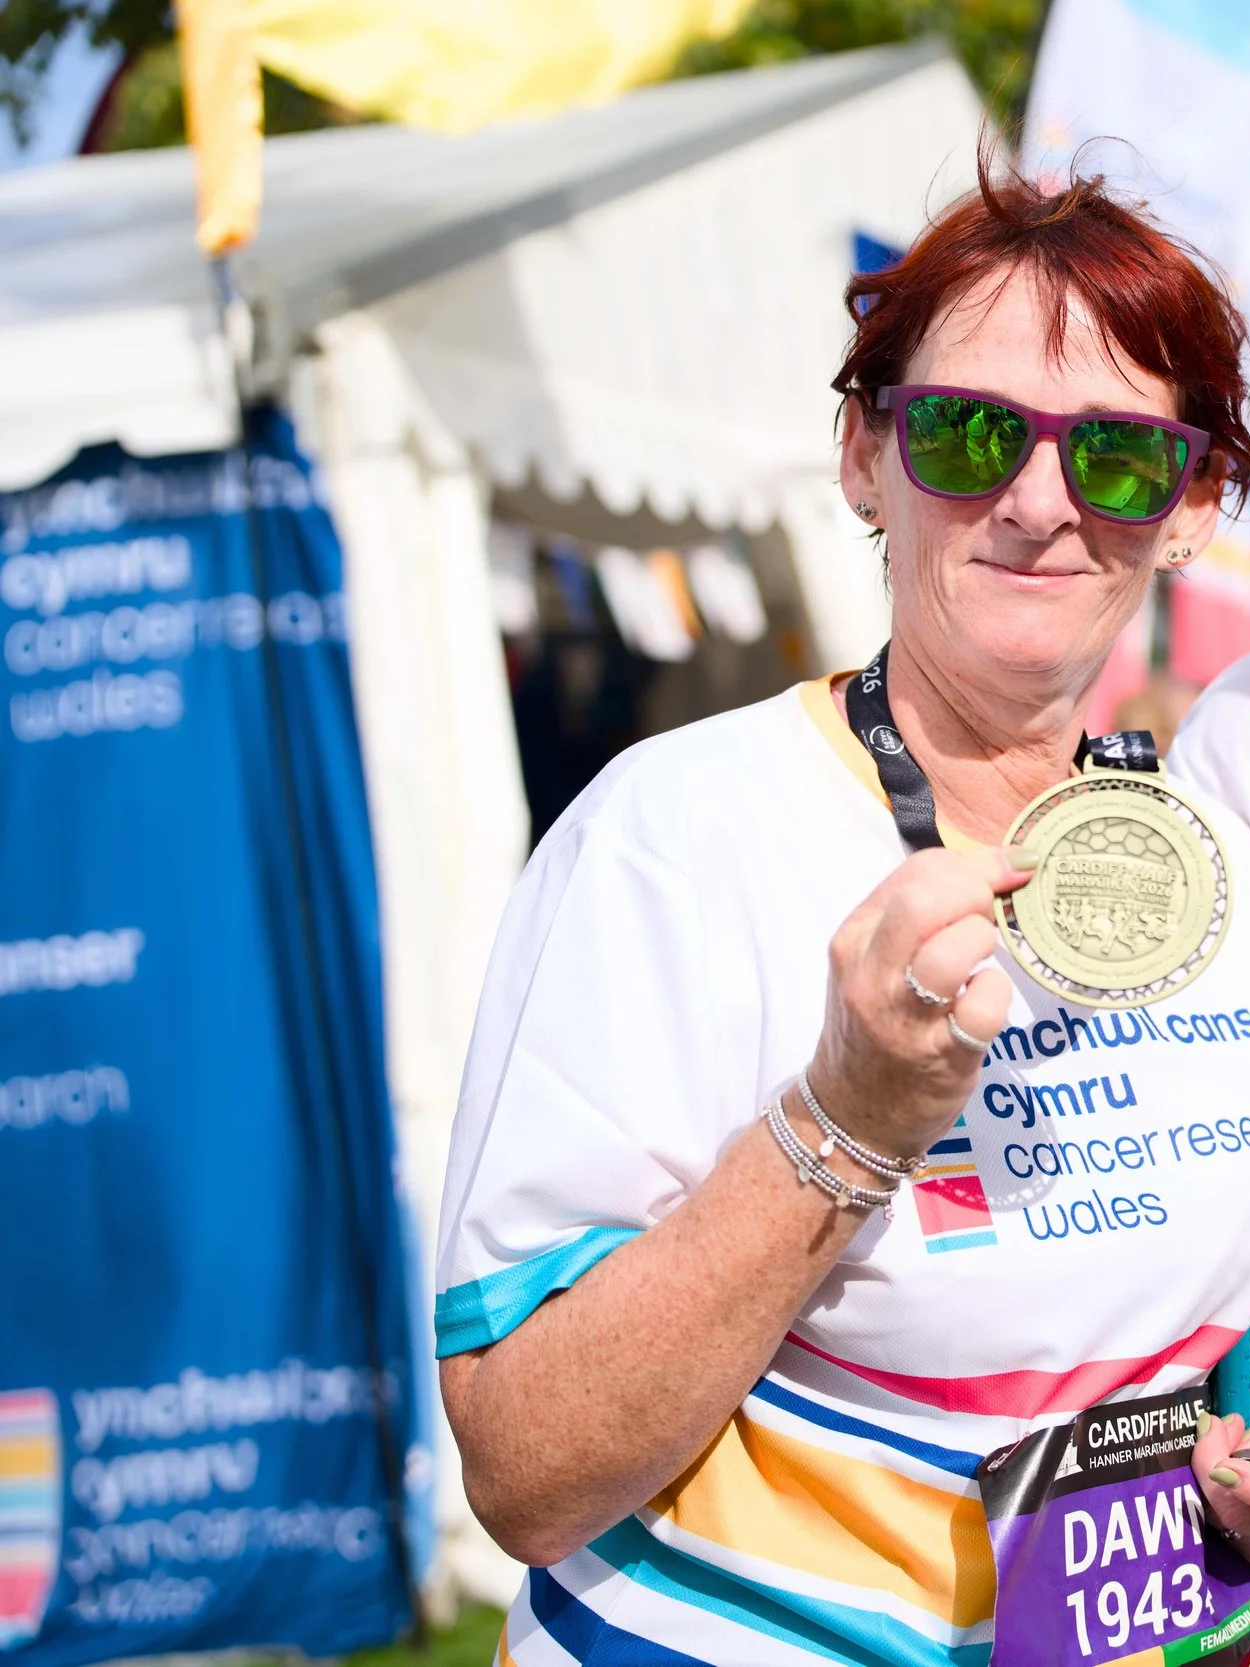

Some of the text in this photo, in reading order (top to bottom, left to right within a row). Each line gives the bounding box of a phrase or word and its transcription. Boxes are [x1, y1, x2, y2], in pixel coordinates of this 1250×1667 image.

[1056, 861, 1129, 876] CARDIFF
[983, 1073, 1137, 1128] cymru
[1004, 1131, 1158, 1179] cancer
[1022, 1189, 1168, 1241] wales
[1088, 1409, 1168, 1448] CARDIFF
[1089, 1449, 1133, 1470] HANNER
[1134, 1440, 1175, 1460] MARATHON
